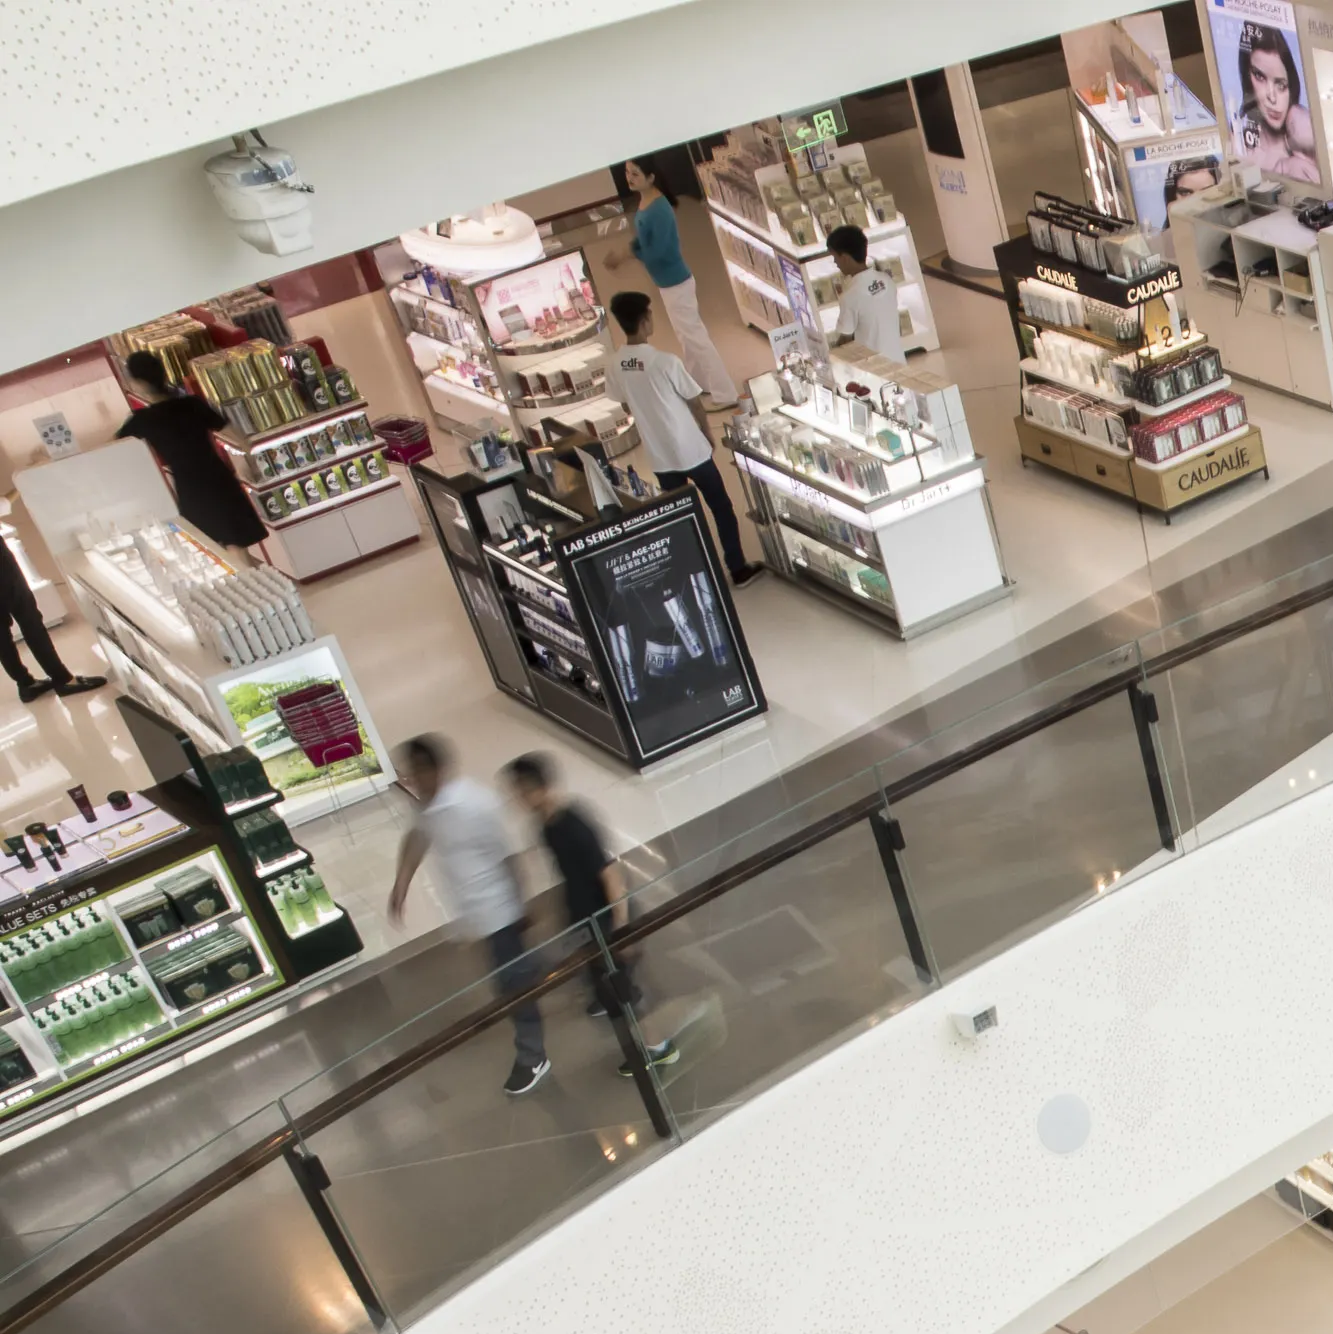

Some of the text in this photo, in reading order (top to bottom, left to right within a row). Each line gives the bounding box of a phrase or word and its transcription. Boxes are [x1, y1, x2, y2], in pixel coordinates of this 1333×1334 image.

[563, 496, 692, 556] LAB SERIES SKINCARE FOR MEN
[631, 536, 671, 559] AGE-DEFY
[26, 903, 57, 922] SETS
